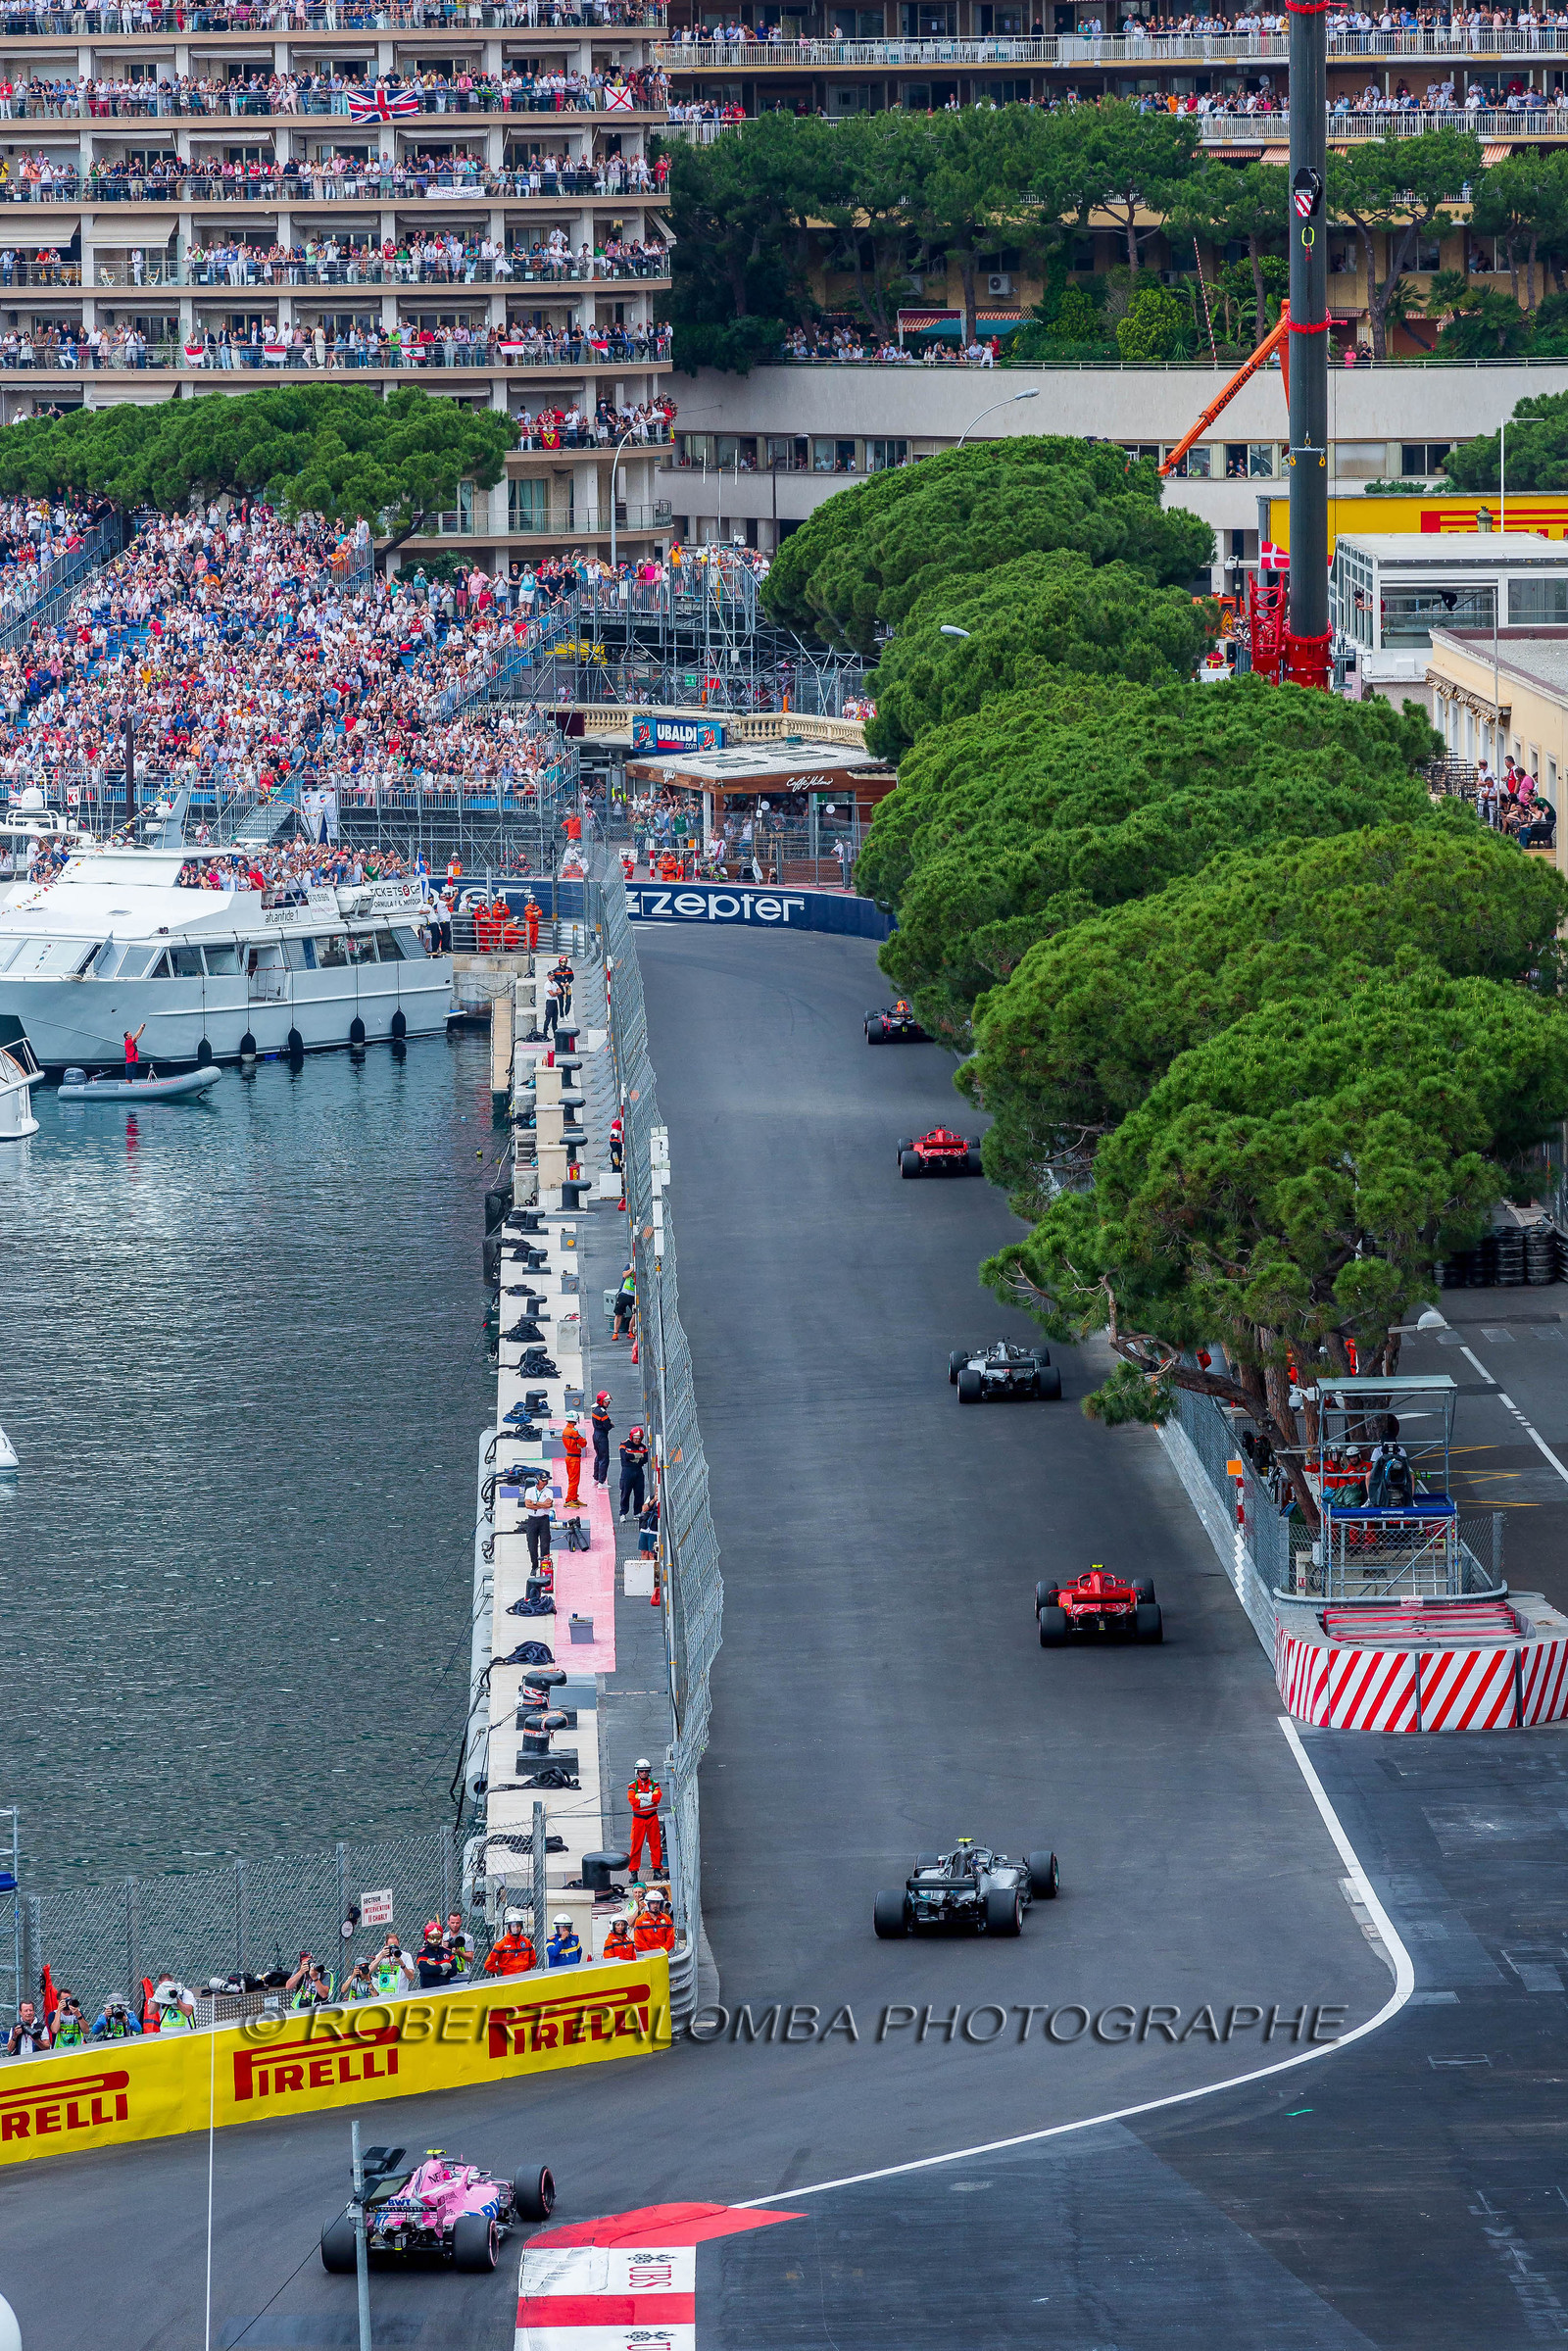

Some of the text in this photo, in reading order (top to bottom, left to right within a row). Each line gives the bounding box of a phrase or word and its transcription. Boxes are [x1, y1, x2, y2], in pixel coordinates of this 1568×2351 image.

[657, 723, 698, 742] UBALDI
[488, 1984, 651, 2059] PIRELLI
[233, 2025, 401, 2101] PIRELLI
[0, 2070, 129, 2141] RELLI
[388, 2198, 412, 2207] BWT
[628, 2265, 672, 2287] UBS
